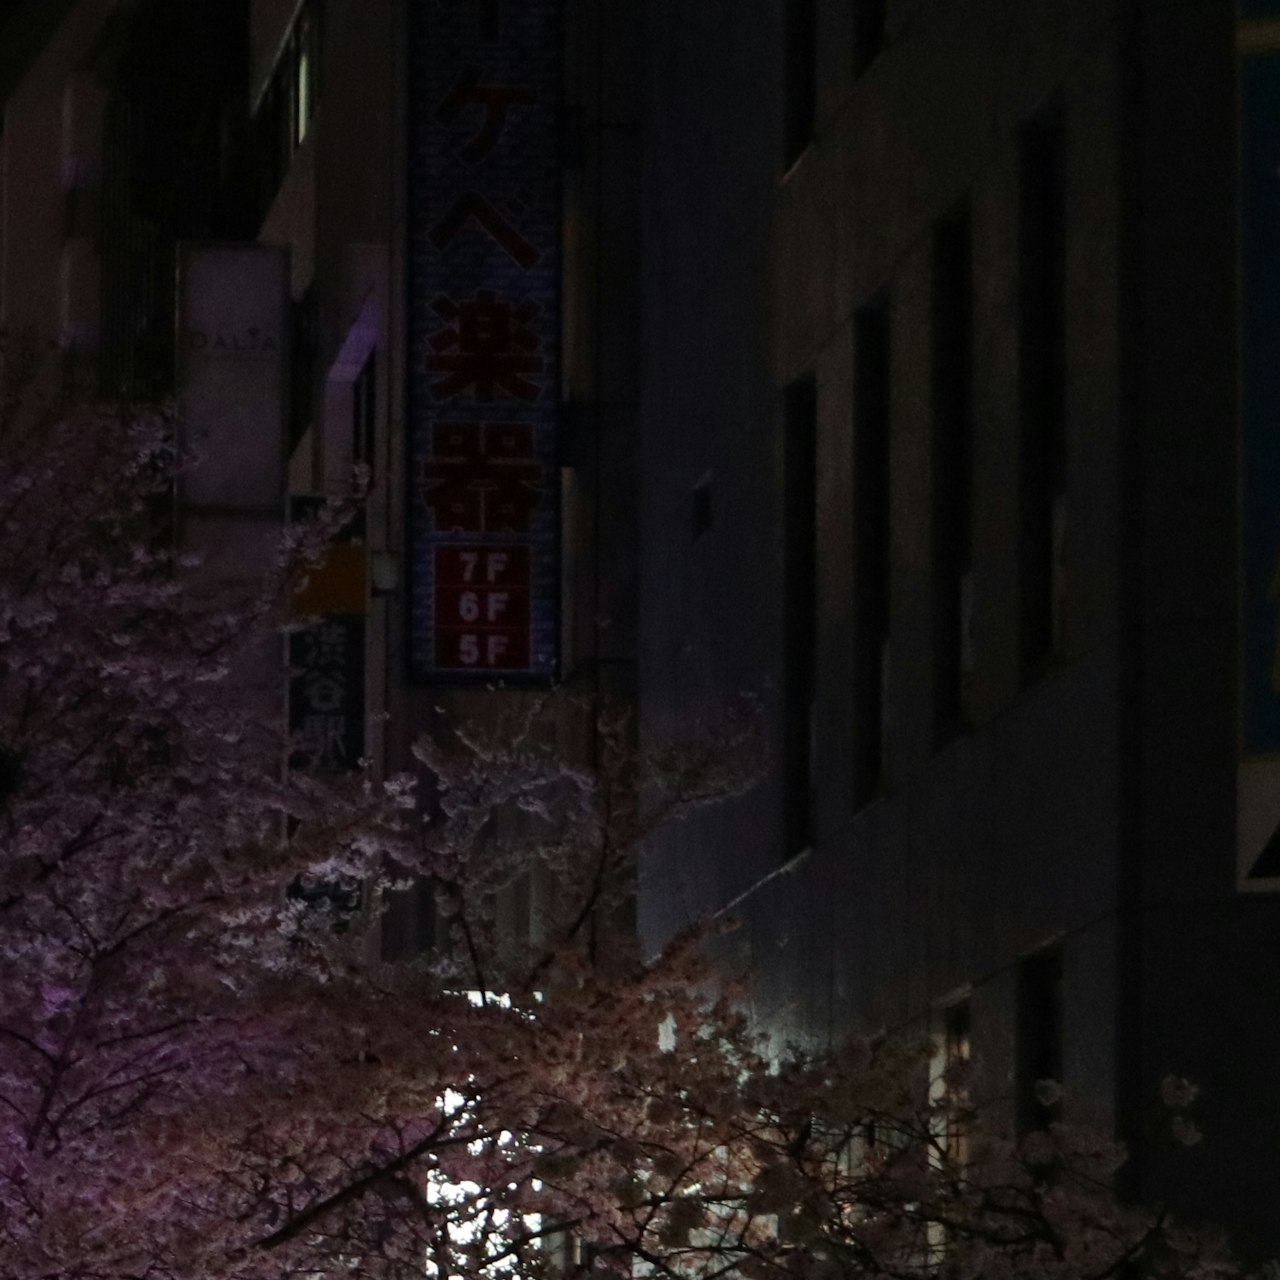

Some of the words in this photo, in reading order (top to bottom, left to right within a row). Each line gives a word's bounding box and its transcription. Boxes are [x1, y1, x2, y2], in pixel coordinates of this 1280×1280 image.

[458, 552, 509, 583] 7F
[458, 591, 509, 622] 6F
[458, 634, 509, 665] 5F
